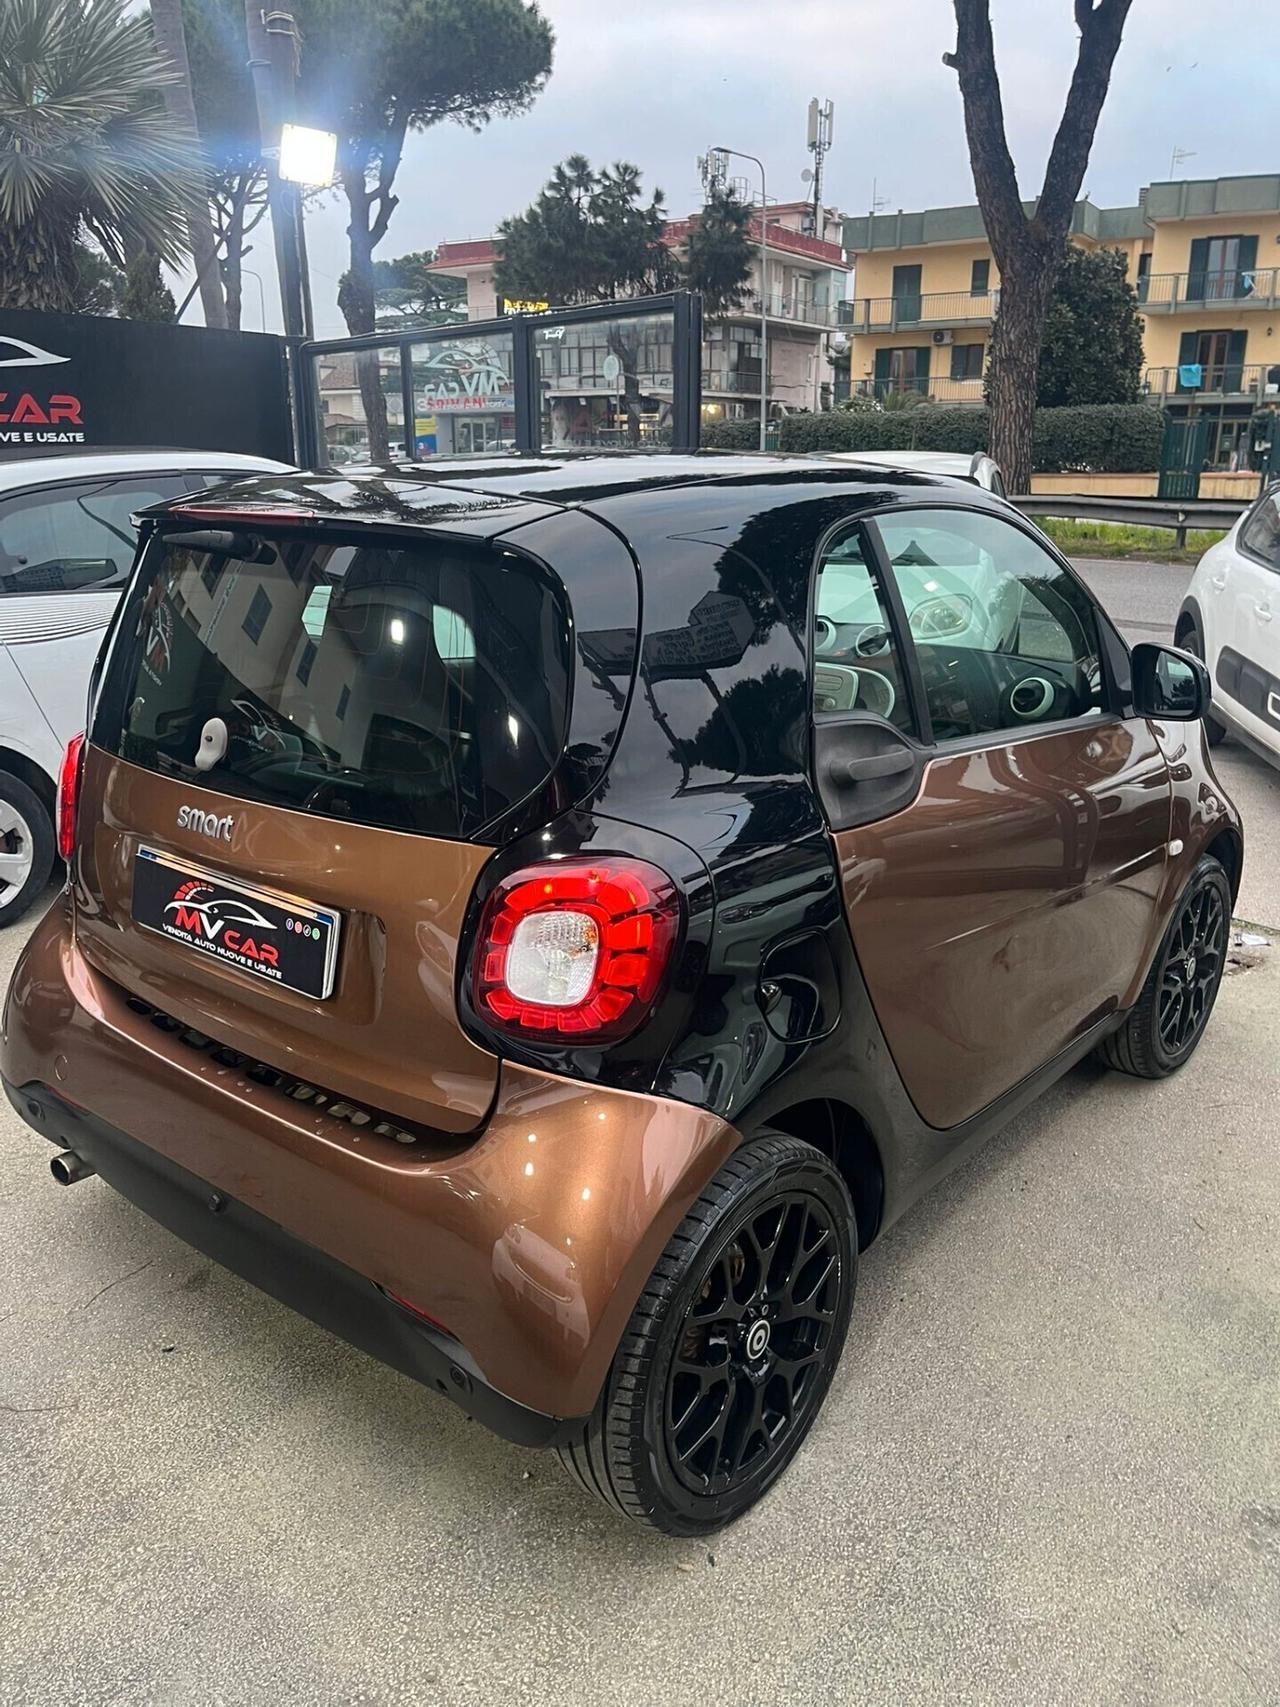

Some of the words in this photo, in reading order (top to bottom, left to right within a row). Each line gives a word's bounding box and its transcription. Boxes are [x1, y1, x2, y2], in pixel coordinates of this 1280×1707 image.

[23, 432, 34, 443] E
[36, 432, 85, 443] USATE
[177, 805, 235, 842] smart
[162, 923, 193, 942] VENDITA
[194, 937, 216, 952] AUTO
[217, 946, 246, 964] NUOVE
[246, 960, 253, 968] E
[254, 962, 282, 979] USATE
[175, 905, 225, 940] MV
[224, 930, 279, 968] CAR
